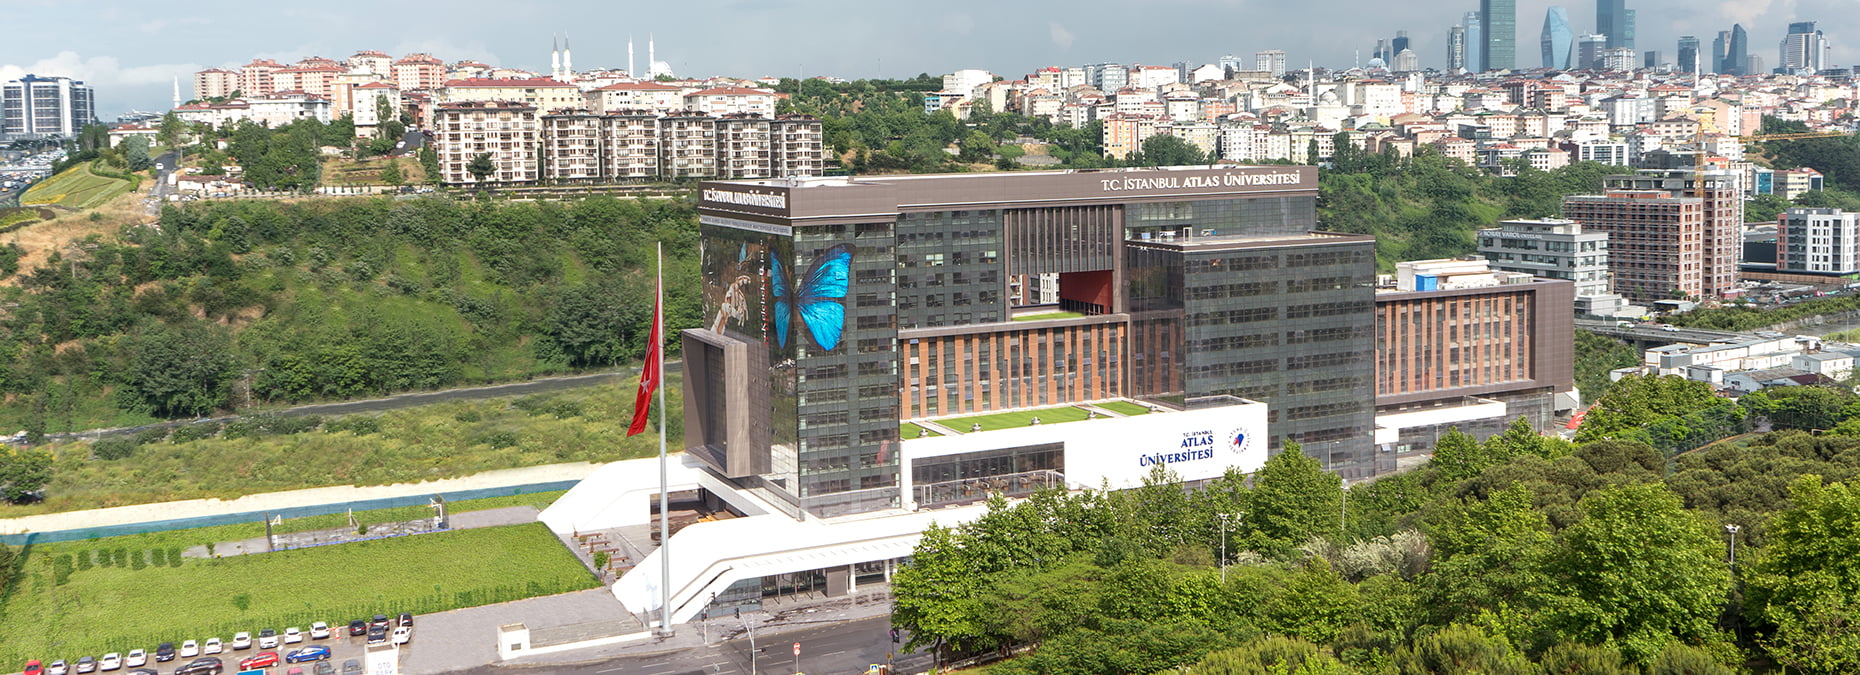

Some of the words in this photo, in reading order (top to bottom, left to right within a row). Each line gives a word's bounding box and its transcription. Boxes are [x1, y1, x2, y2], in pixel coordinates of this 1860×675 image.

[1123, 176, 1180, 190] İSTANBUL
[1183, 176, 1220, 188] ATLAS
[1223, 170, 1300, 186] ÜNİVERSİTESİ
[1181, 435, 1214, 449] ATLAS
[1140, 446, 1213, 467] ÜNİVERSİTESİ
